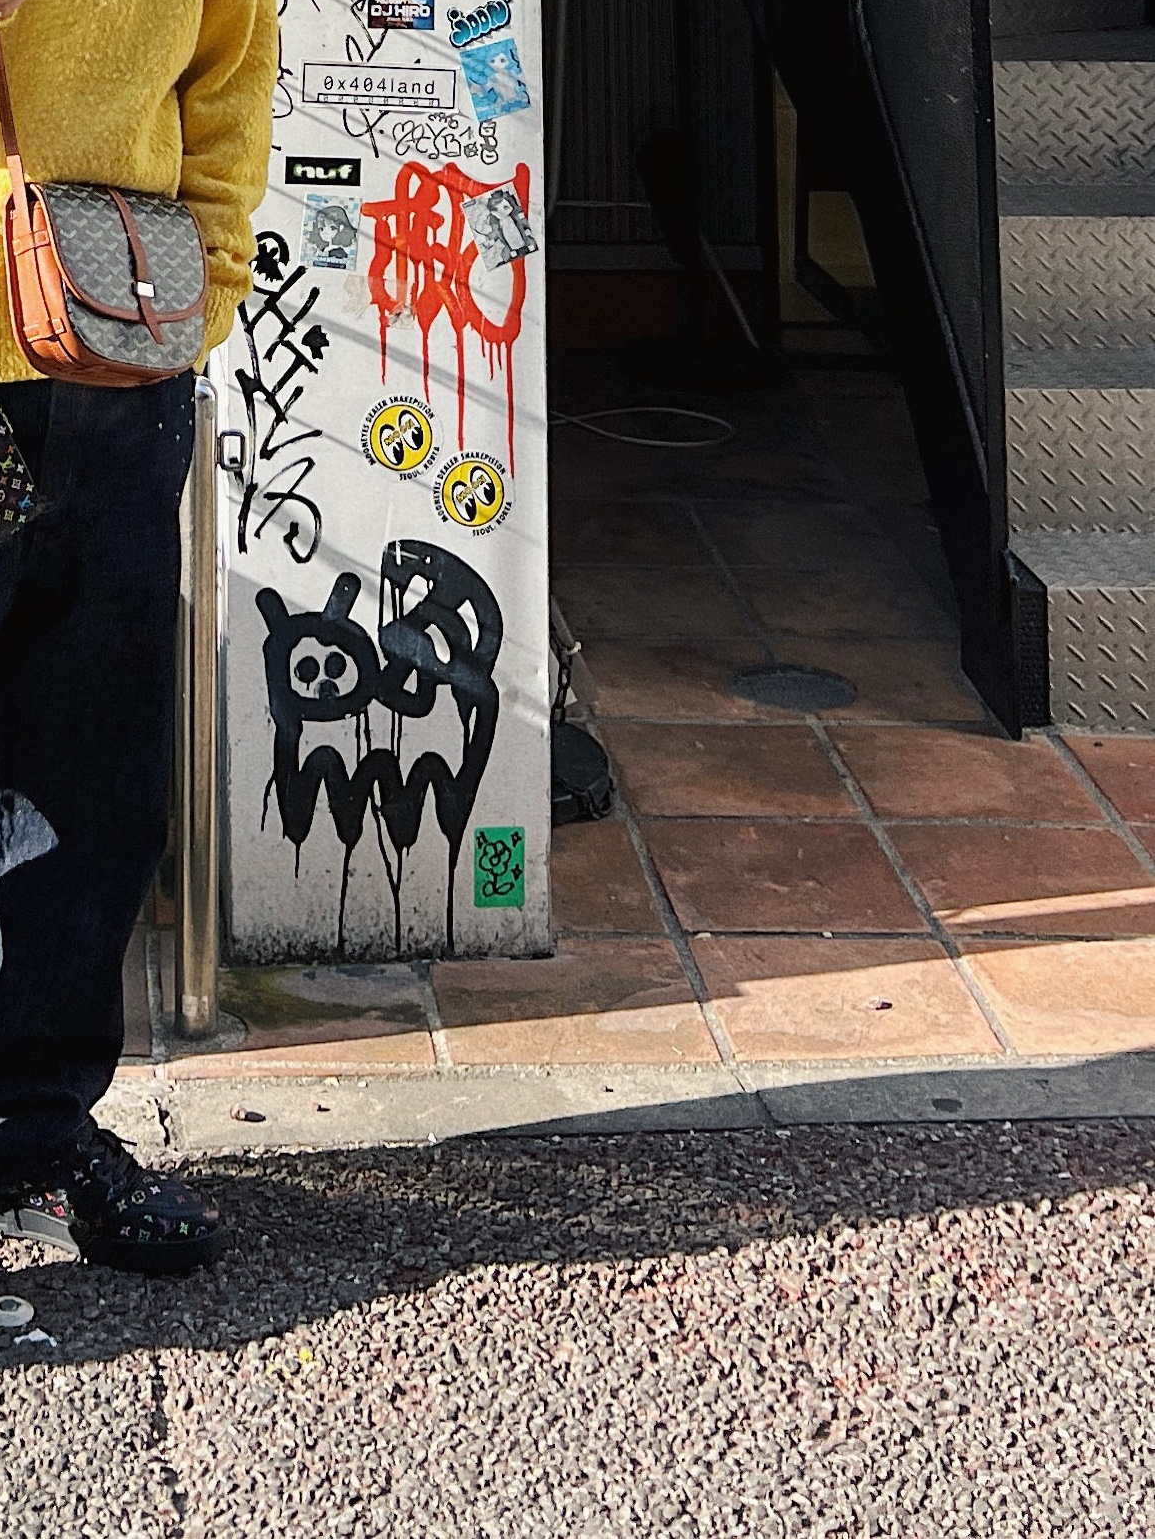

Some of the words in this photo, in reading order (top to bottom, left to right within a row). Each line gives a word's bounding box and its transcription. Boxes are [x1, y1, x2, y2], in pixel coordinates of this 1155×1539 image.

[370, 4, 393, 18] DJ
[394, 4, 431, 18] HIRO
[323, 75, 436, 95] 0x404land
